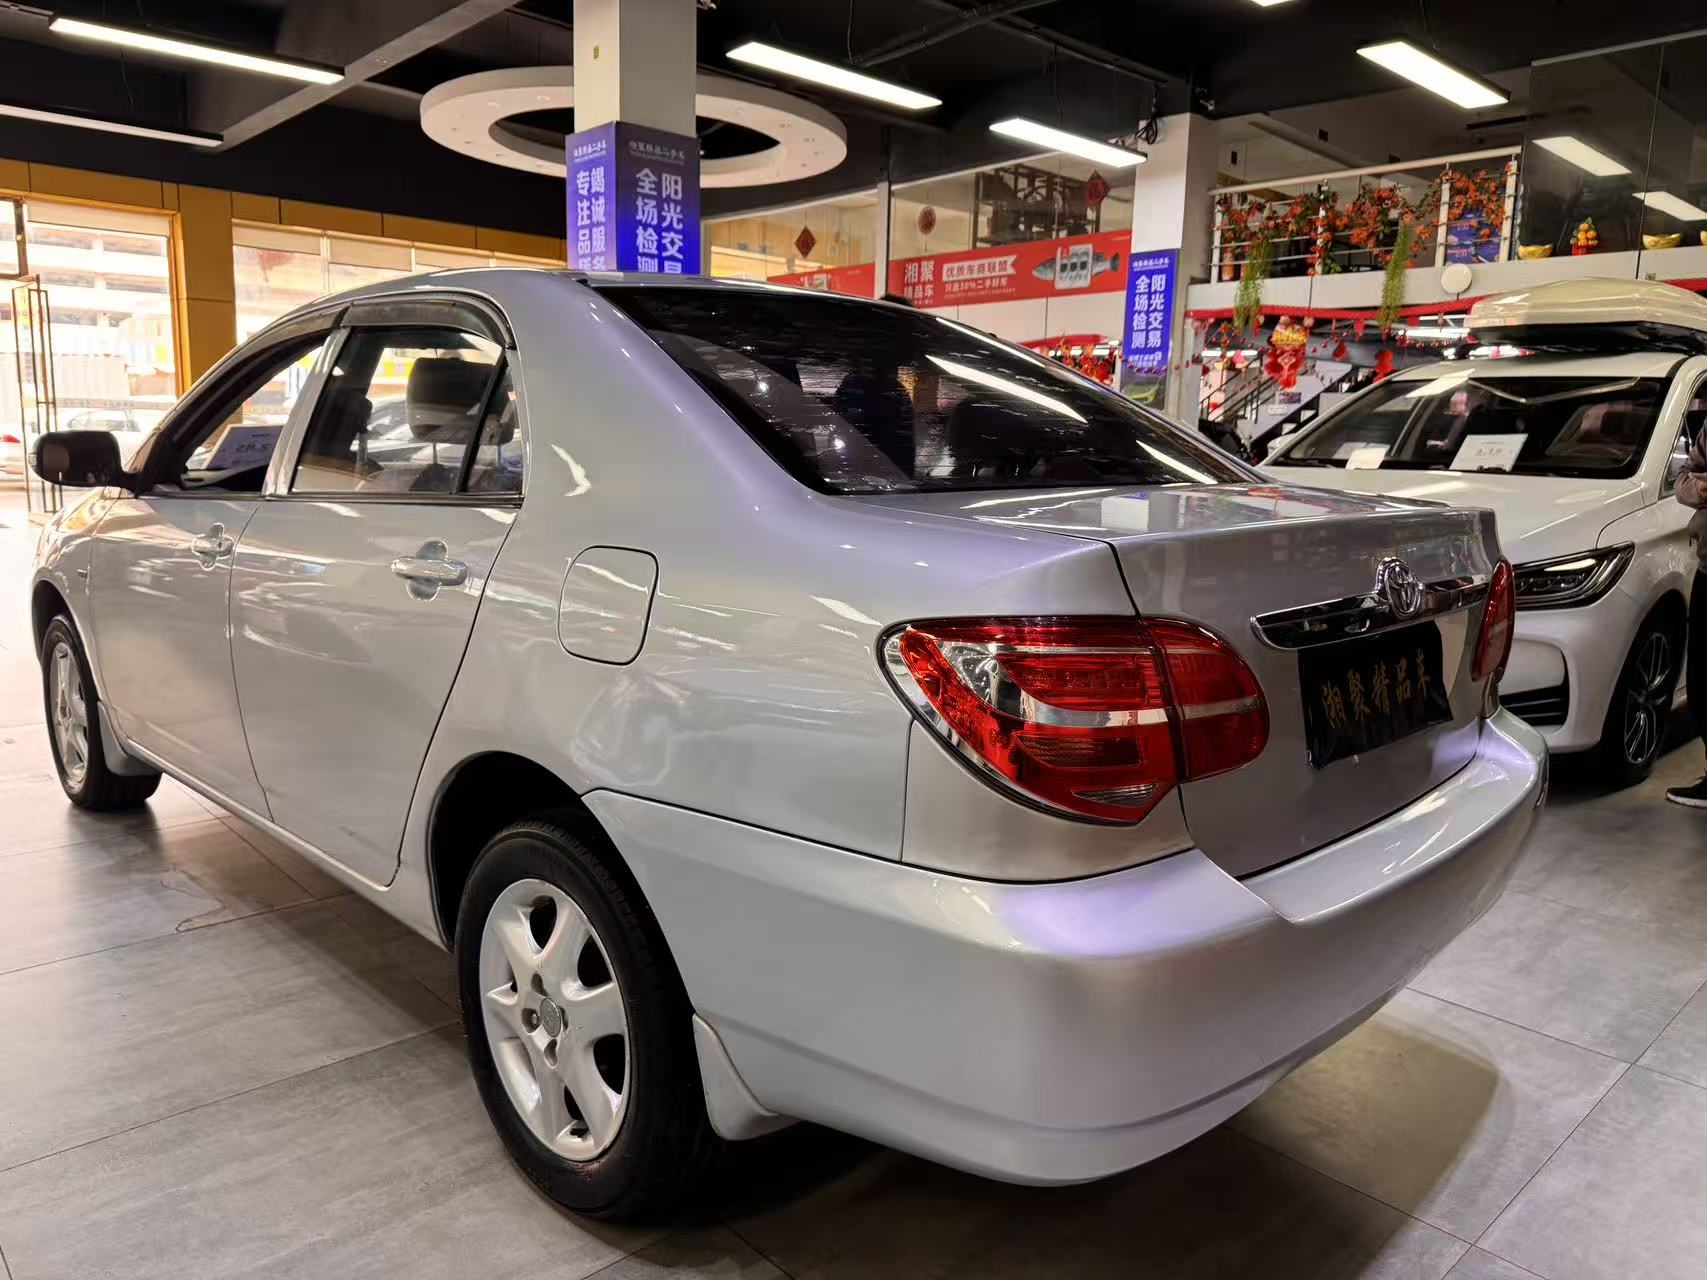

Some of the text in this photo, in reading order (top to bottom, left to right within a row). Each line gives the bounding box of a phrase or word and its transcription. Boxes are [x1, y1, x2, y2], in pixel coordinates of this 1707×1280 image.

[635, 167, 659, 272] 全场检测
[904, 260, 935, 284] 湘聚
[946, 259, 1009, 279] 优质车商联盟
[1131, 274, 1151, 350] 全场检测
[1146, 273, 1167, 348] 阳光交易
